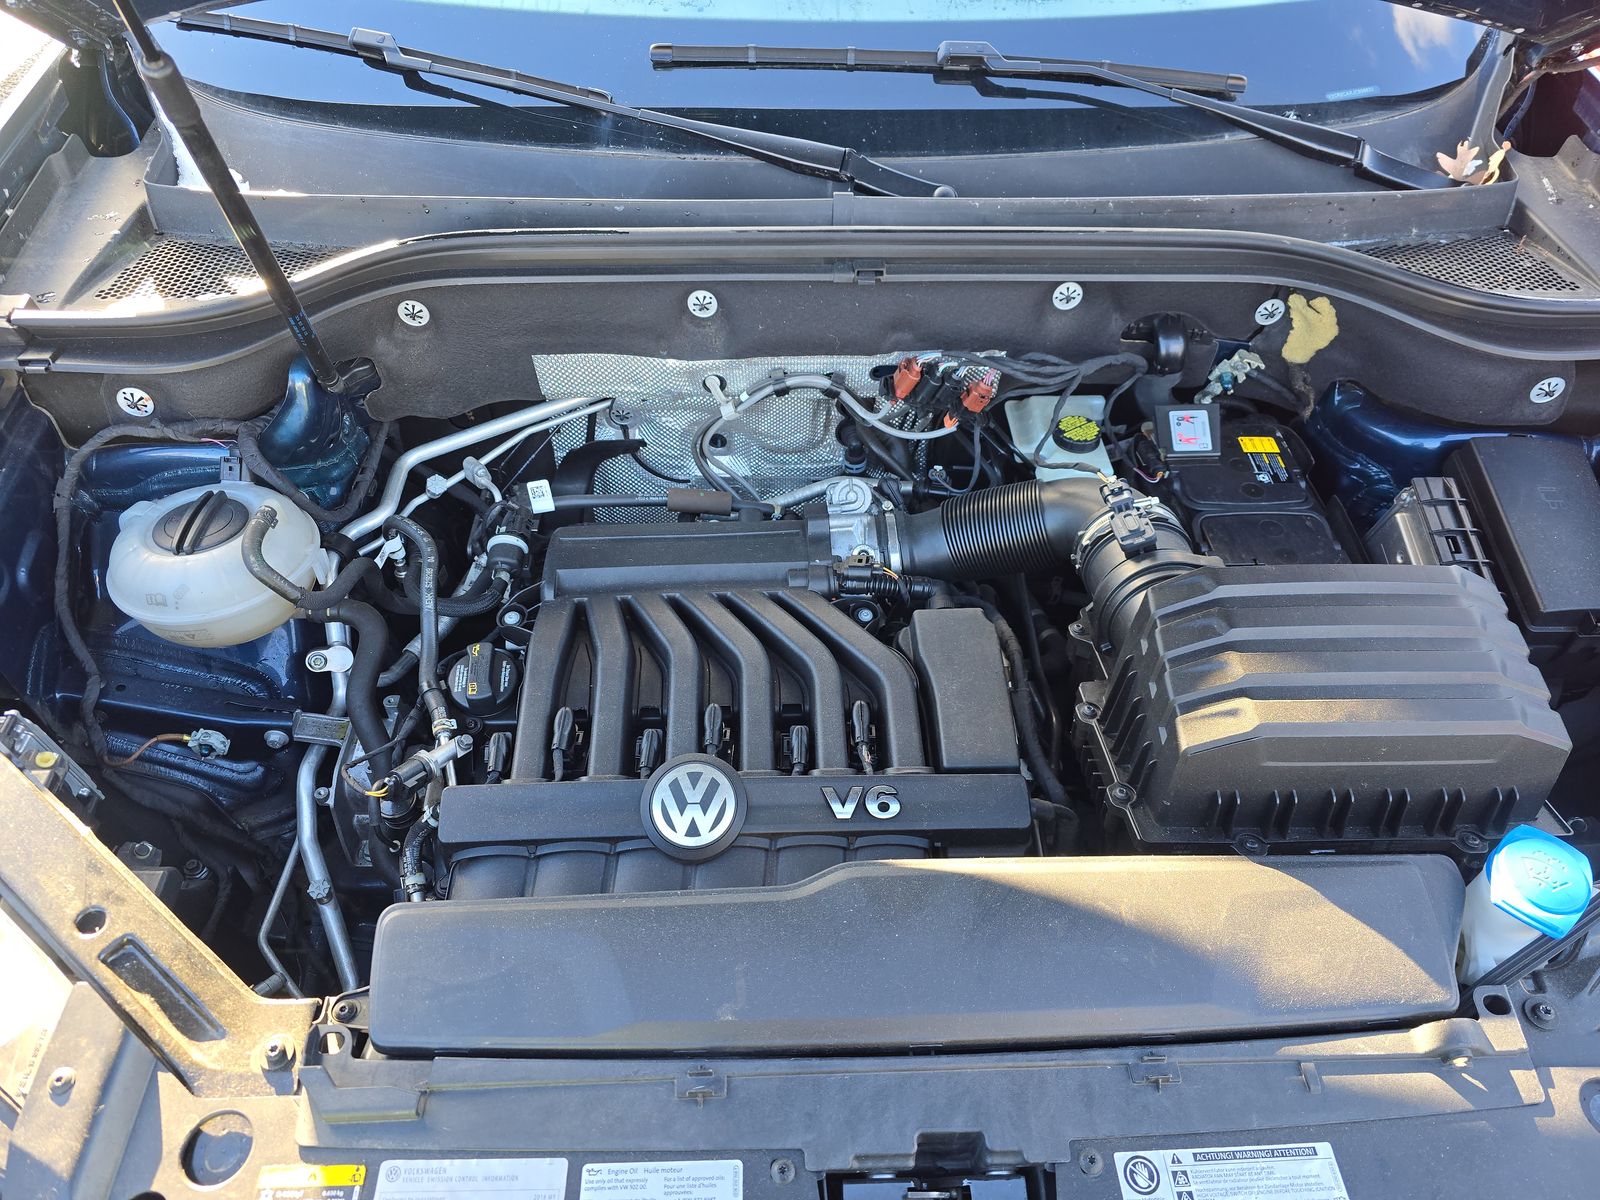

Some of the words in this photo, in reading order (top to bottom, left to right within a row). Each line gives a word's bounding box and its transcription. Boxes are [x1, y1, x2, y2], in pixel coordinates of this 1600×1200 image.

[652, 763, 736, 847] VW
[821, 784, 901, 820] V6
[1196, 1151, 1234, 1161] ACHTUNG!
[1235, 1150, 1272, 1159] WARNING!
[1274, 1148, 1314, 1158] ATTENTION!
[404, 1167, 448, 1175] VOLKSWAGEN
[608, 1168, 628, 1176] Engine
[402, 1176, 424, 1184] VEHICLE
